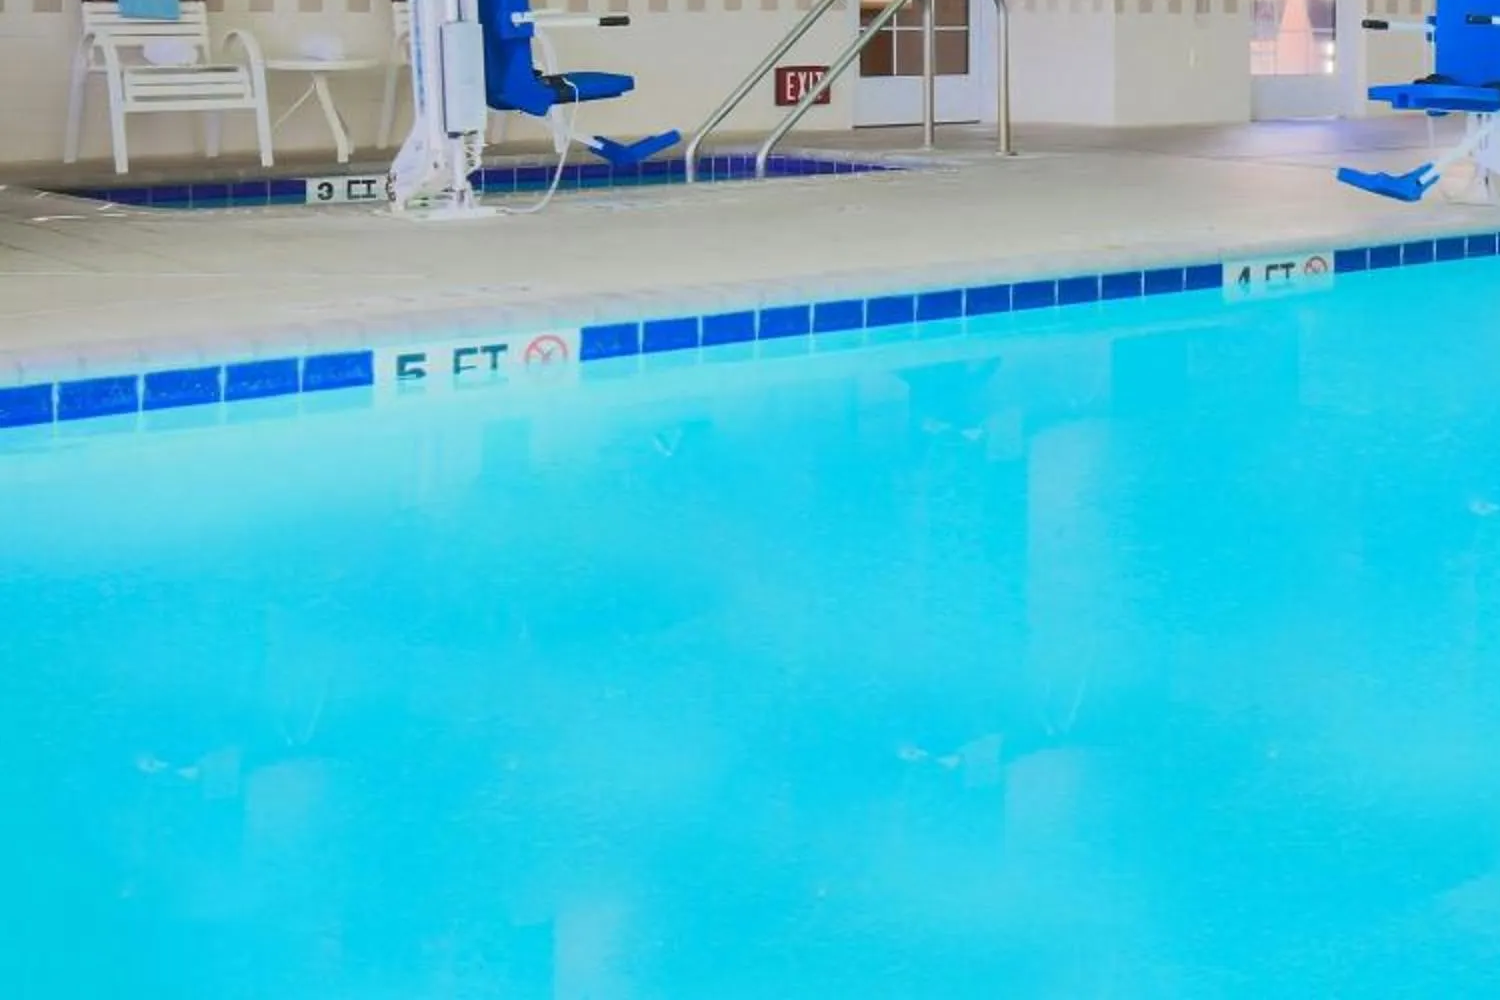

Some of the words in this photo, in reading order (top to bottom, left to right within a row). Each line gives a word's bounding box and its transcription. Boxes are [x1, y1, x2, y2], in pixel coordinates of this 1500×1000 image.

[317, 181, 334, 200] 3
[396, 352, 427, 381] 5
[453, 343, 509, 375] FT
